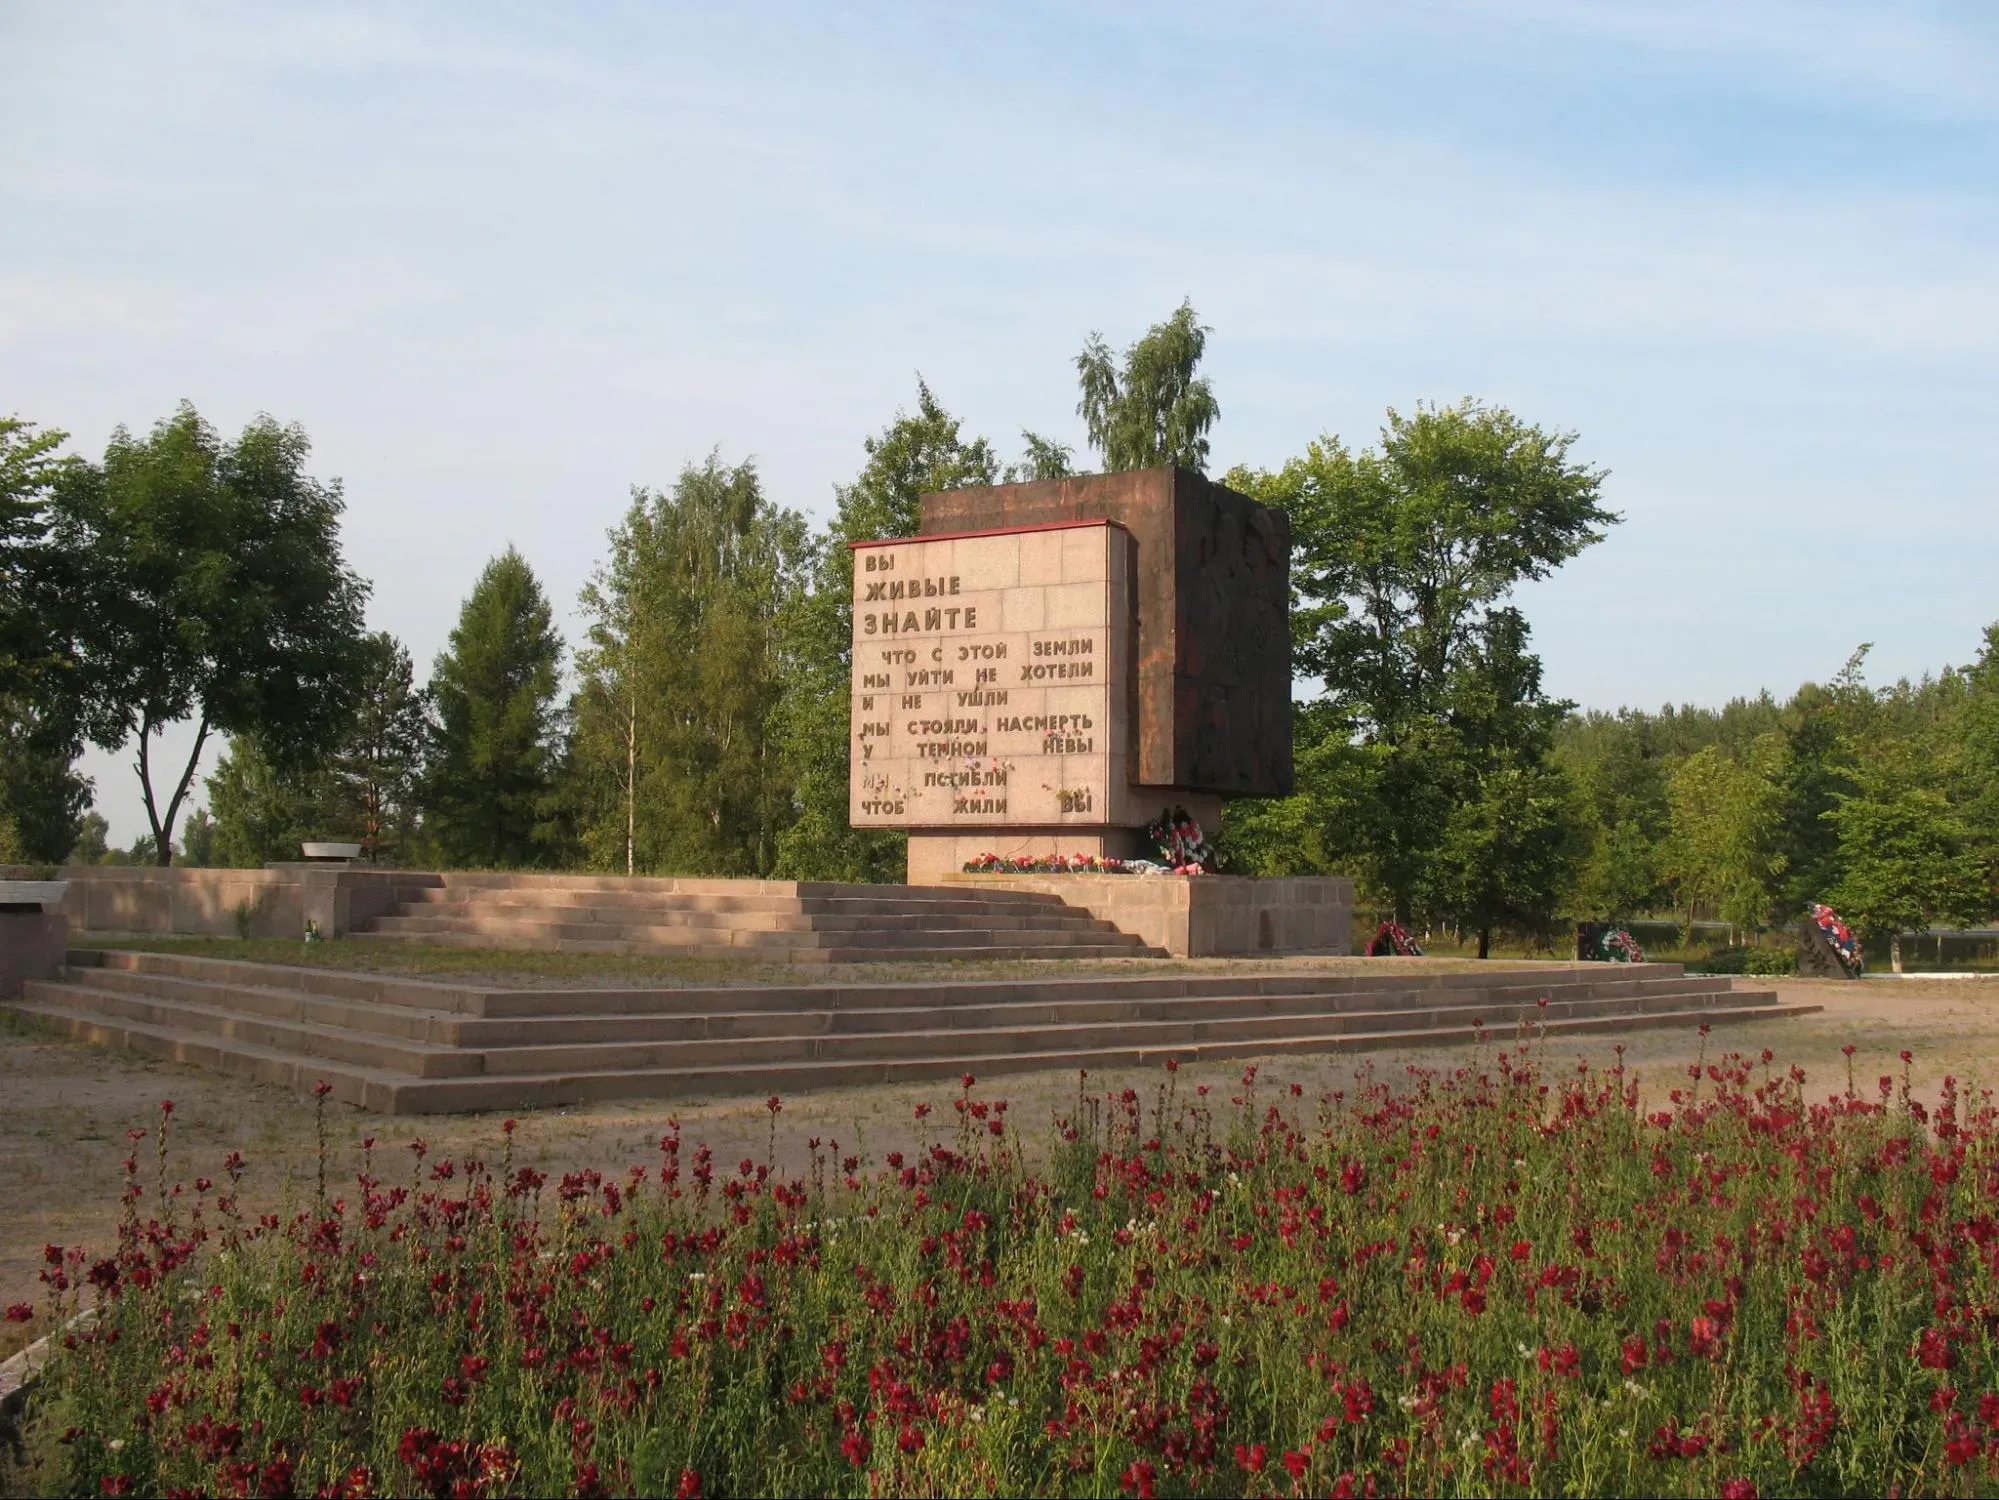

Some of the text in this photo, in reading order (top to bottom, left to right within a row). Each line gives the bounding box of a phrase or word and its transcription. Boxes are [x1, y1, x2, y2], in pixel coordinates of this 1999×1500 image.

[865, 554, 894, 572] ВЫ
[864, 576, 960, 602] ЖИВЫЕ
[864, 607, 976, 635] ЗНАЙТЕ
[881, 638, 1093, 665] ЧТО С ЭТОЙ ЗЕМЛИ
[863, 661, 1093, 688] МЫ УЙТИ НЕ ХОТЕЛИ
[862, 690, 1008, 711] И НЕ УШЛИ
[862, 714, 1093, 737] МЫ СТОЯЛИ НАСМЕРТЬ
[862, 744, 874, 759] У
[1042, 737, 1093, 754] НЕВЫ
[861, 794, 1092, 815] ЧТОБ ЖИЛИ ВЫ
